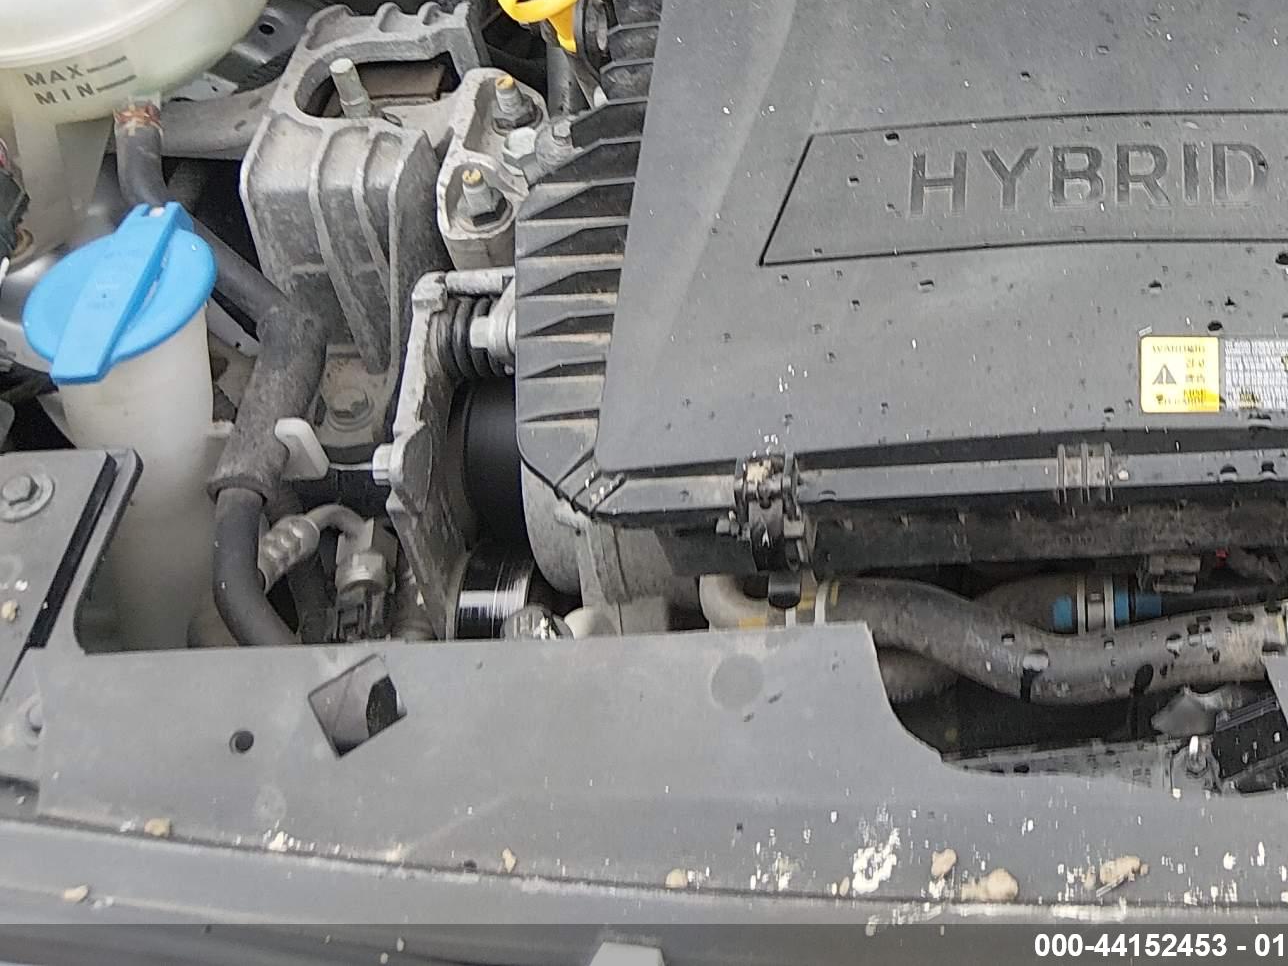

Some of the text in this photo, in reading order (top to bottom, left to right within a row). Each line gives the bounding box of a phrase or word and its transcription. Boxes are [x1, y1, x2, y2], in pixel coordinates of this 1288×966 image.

[24, 63, 84, 87] MAX
[34, 82, 95, 106] MIN
[908, 142, 1270, 218] HYBRID
